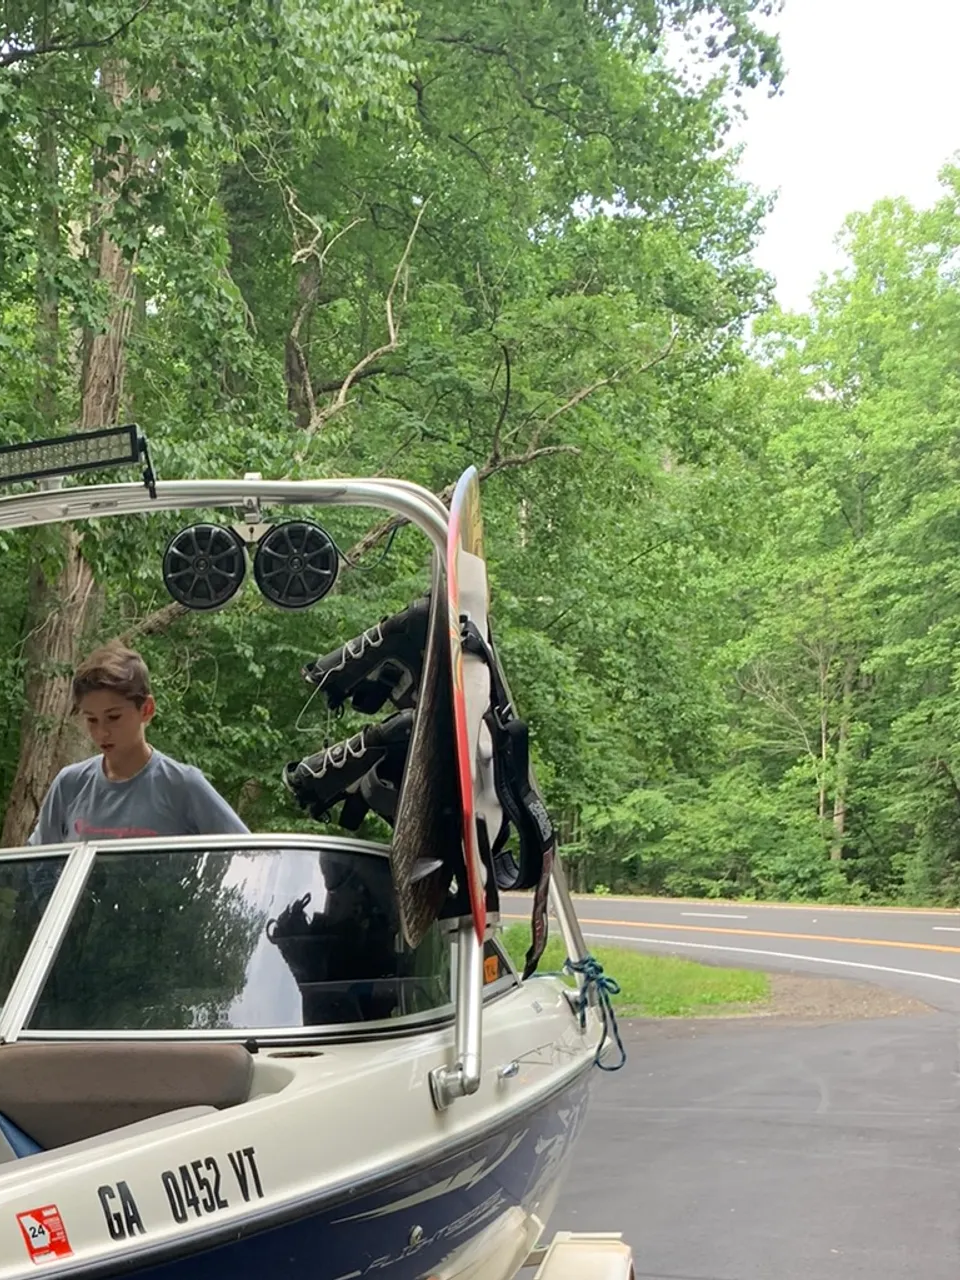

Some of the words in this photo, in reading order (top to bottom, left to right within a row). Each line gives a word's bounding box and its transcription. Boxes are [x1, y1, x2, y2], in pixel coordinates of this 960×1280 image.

[97, 1180, 146, 1241] GA
[161, 1156, 229, 1224] 0452
[228, 1146, 264, 1202] VT
[29, 1224, 45, 1239] 24
